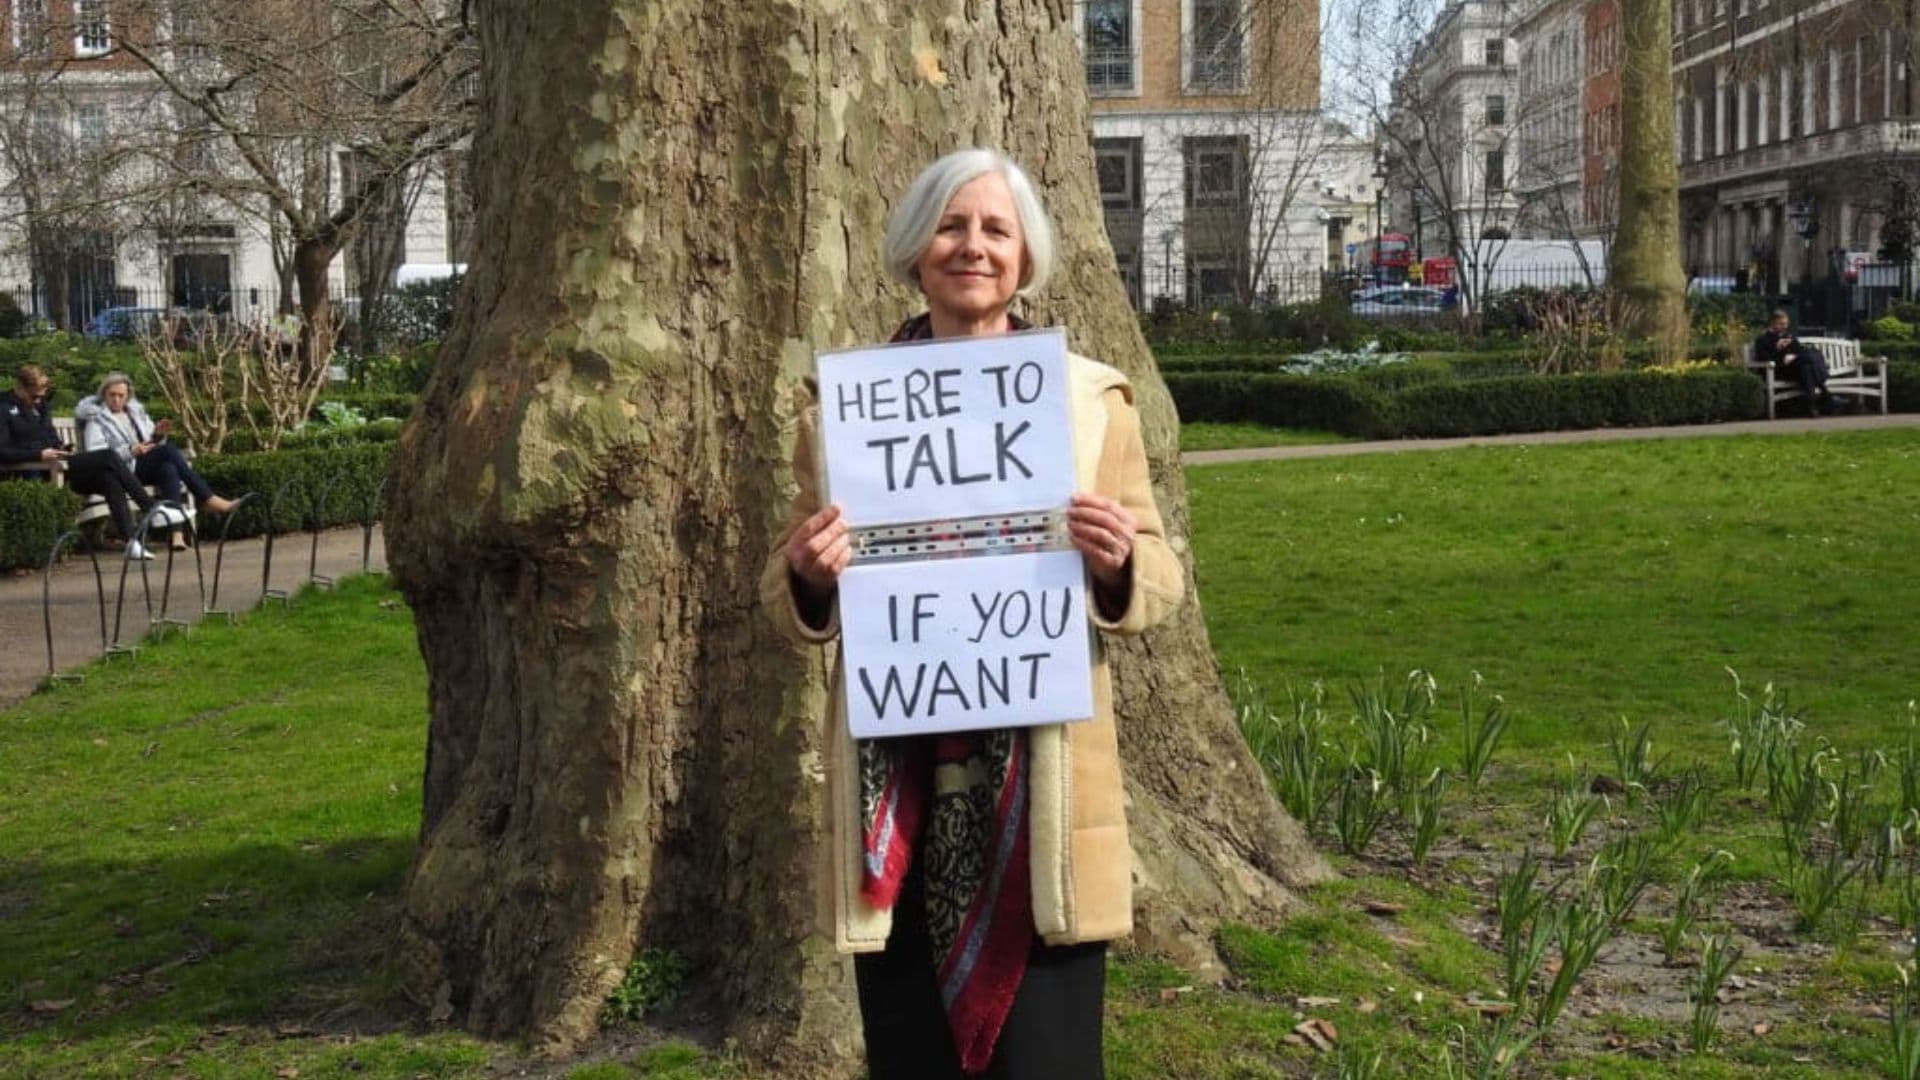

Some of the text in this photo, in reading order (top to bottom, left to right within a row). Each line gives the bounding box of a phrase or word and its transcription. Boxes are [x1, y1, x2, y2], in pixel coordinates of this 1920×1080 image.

[838, 361, 1044, 423] HERE TO
[867, 420, 1034, 492] TALK
[888, 586, 1073, 644] IF YOU
[858, 652, 1052, 720] WANT
